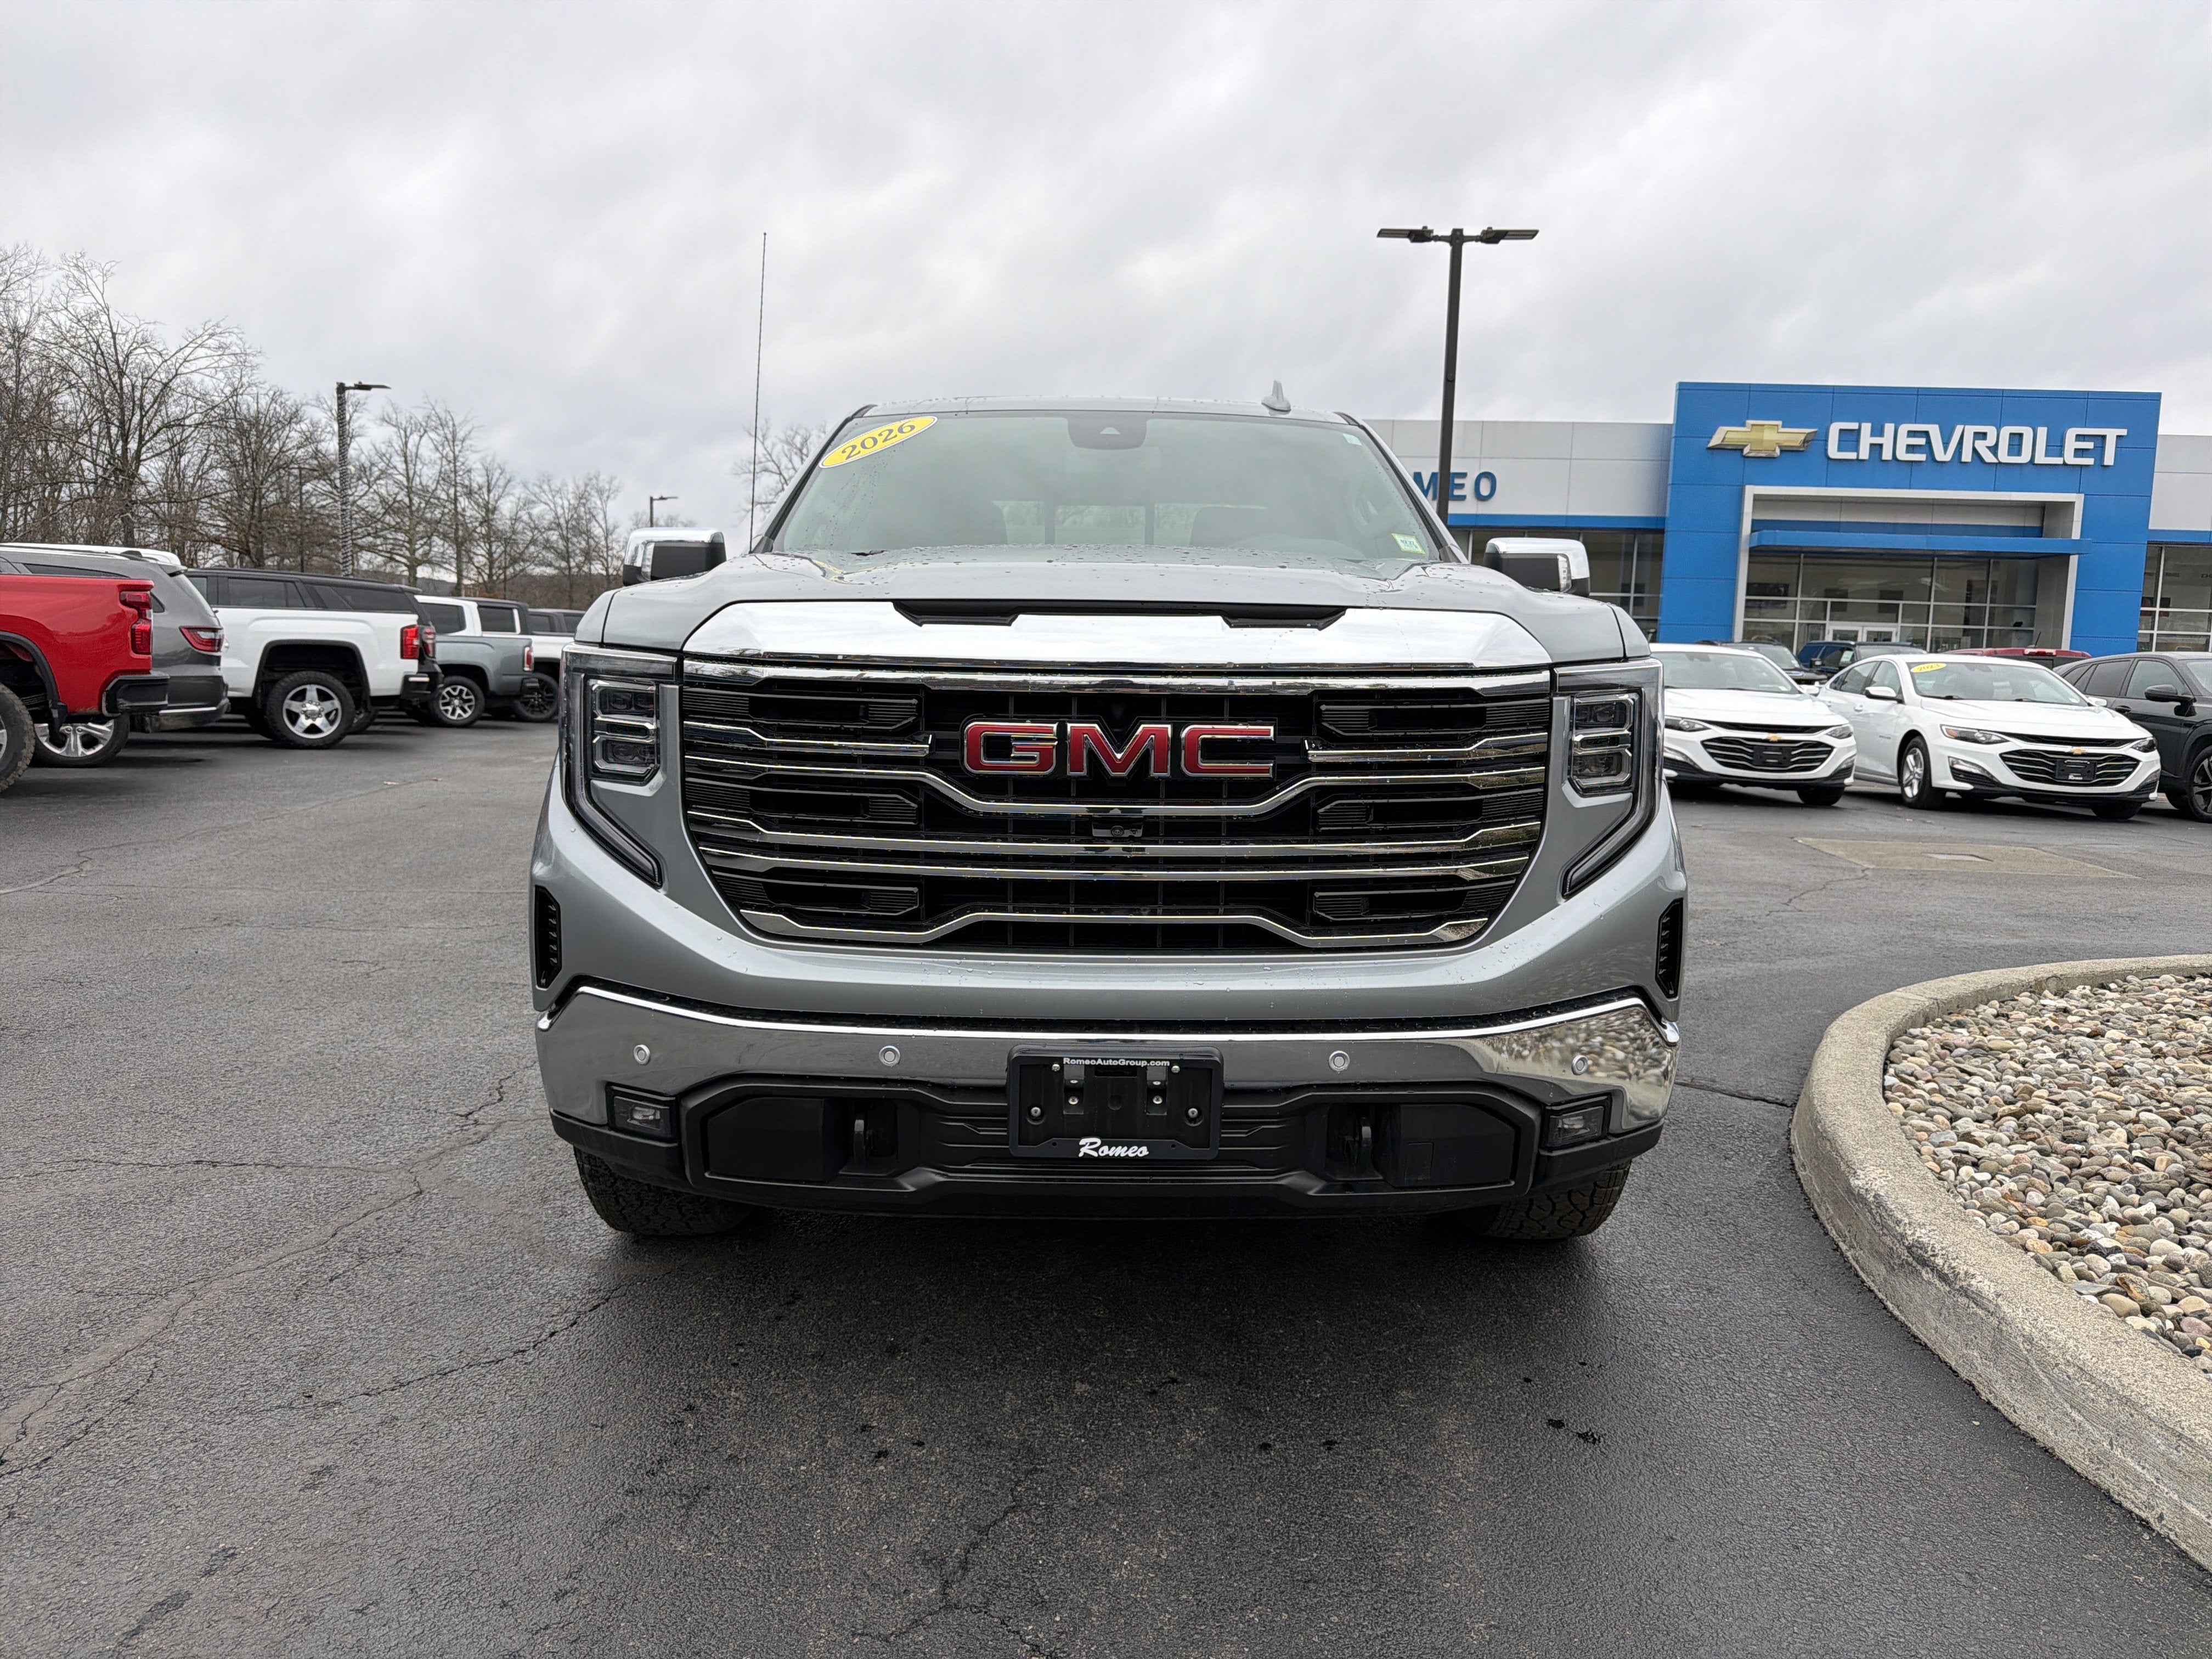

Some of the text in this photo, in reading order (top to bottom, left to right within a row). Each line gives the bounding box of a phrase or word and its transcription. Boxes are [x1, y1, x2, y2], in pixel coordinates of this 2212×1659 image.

[841, 421, 916, 461] 2026
[1827, 421, 2128, 466] CHEVROLET
[964, 721, 1274, 777] GMC
[1063, 1057, 1170, 1067] RomeoAutoGroup.com
[1079, 1137, 1149, 1157] Romeo
